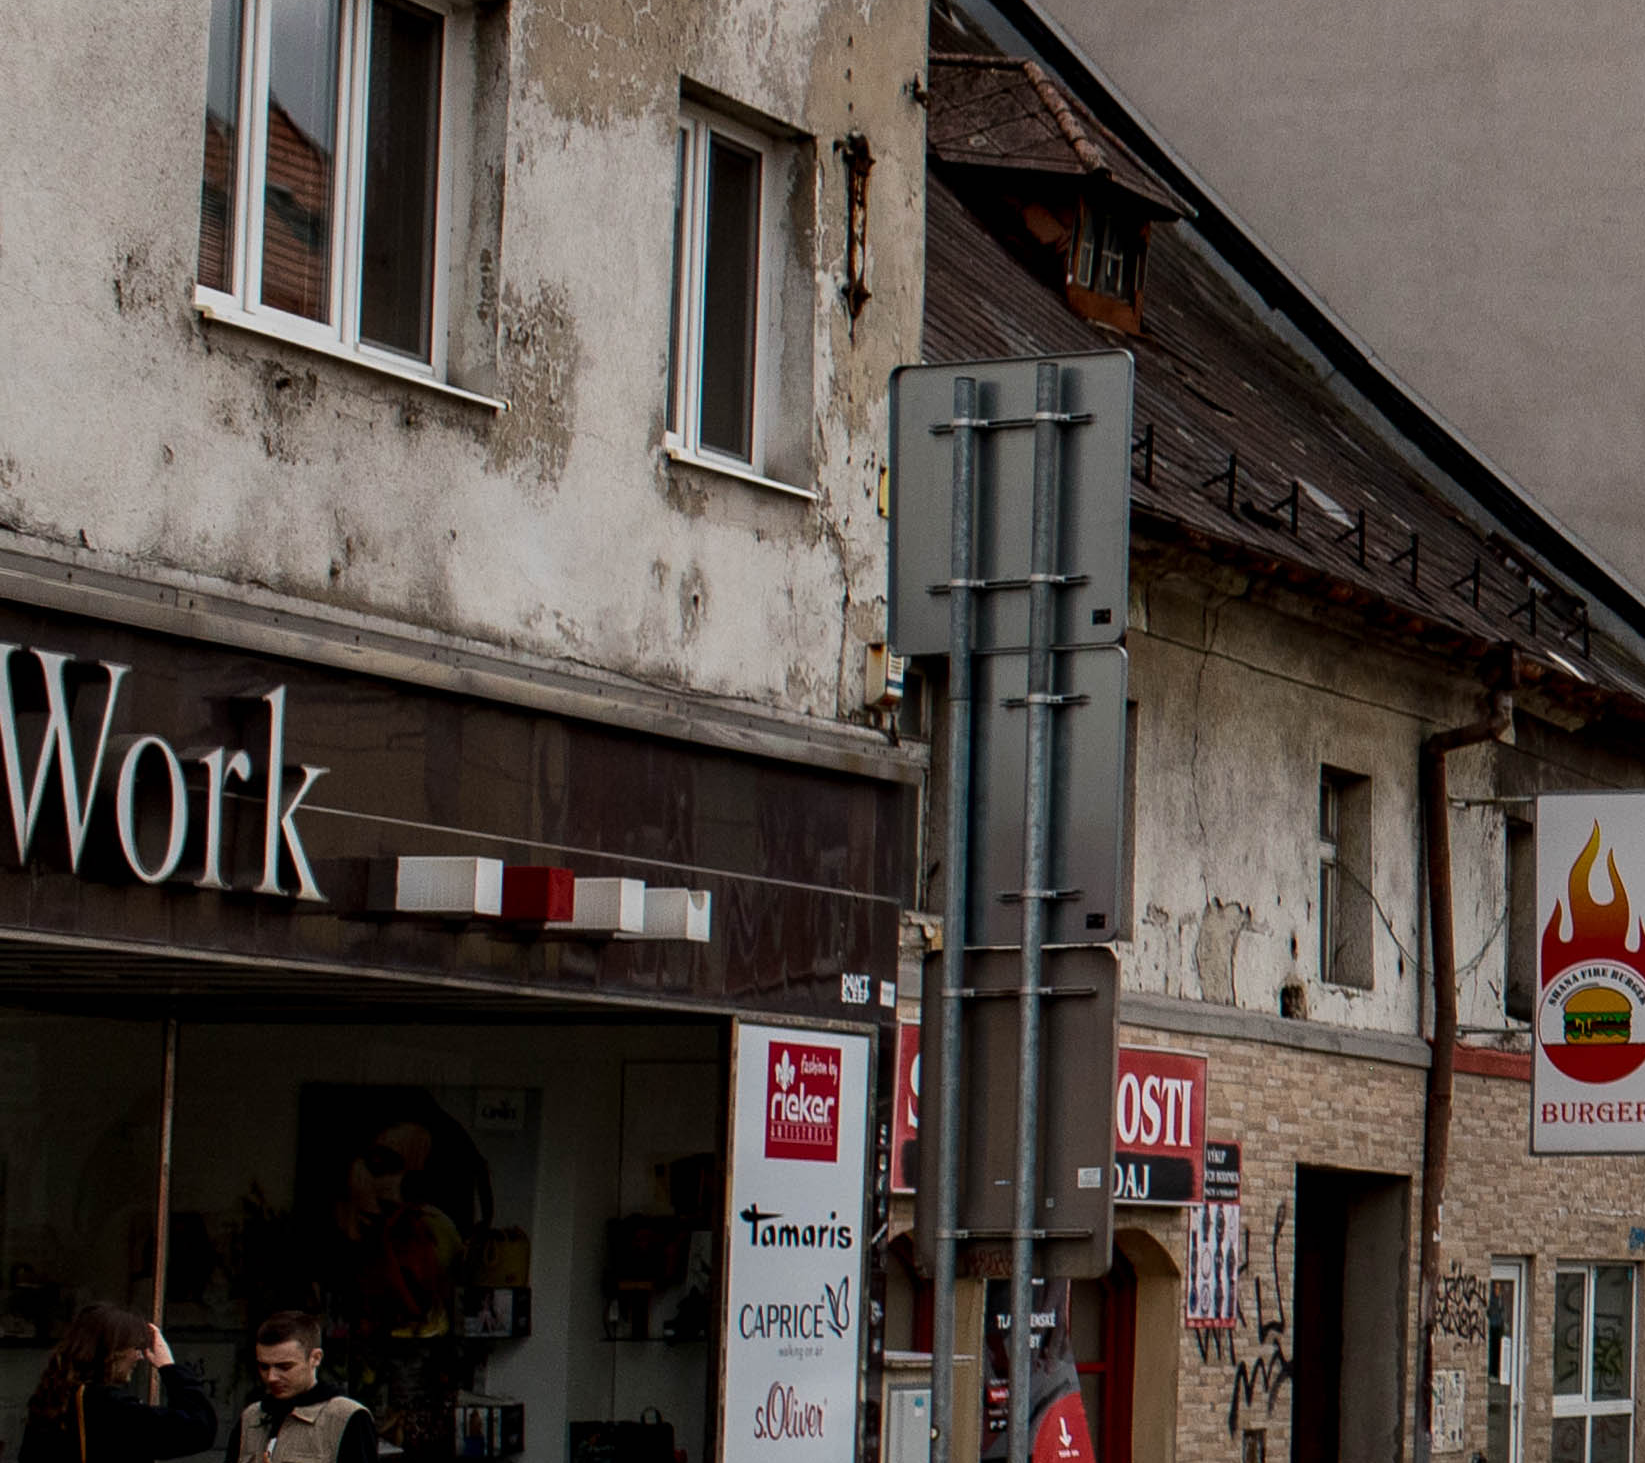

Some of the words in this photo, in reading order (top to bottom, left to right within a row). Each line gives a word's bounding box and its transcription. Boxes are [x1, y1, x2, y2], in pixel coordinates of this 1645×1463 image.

[0, 642, 330, 903] Work
[771, 1081, 835, 1124] rieker
[740, 1203, 853, 1250] Tamaris
[739, 1302, 825, 1340] CAPRICE
[754, 1380, 824, 1440] s.Oliver
